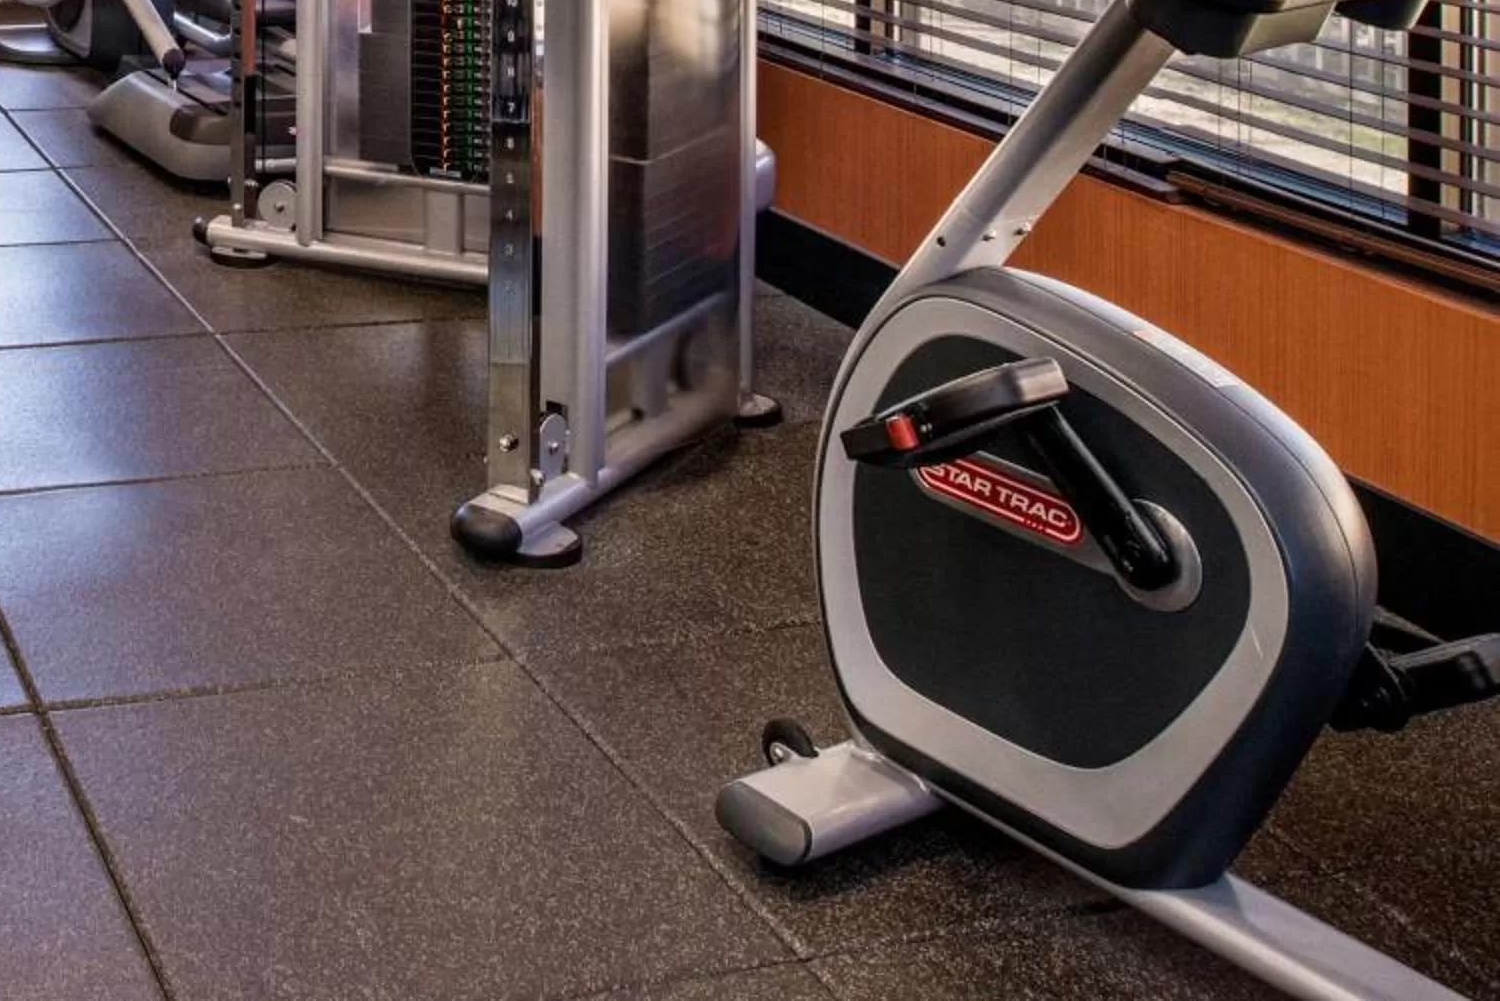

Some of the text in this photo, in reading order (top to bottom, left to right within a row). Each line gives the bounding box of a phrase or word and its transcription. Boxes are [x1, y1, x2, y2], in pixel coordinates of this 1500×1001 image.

[507, 101, 515, 114] 7
[925, 463, 1069, 528] STAR TRAC
